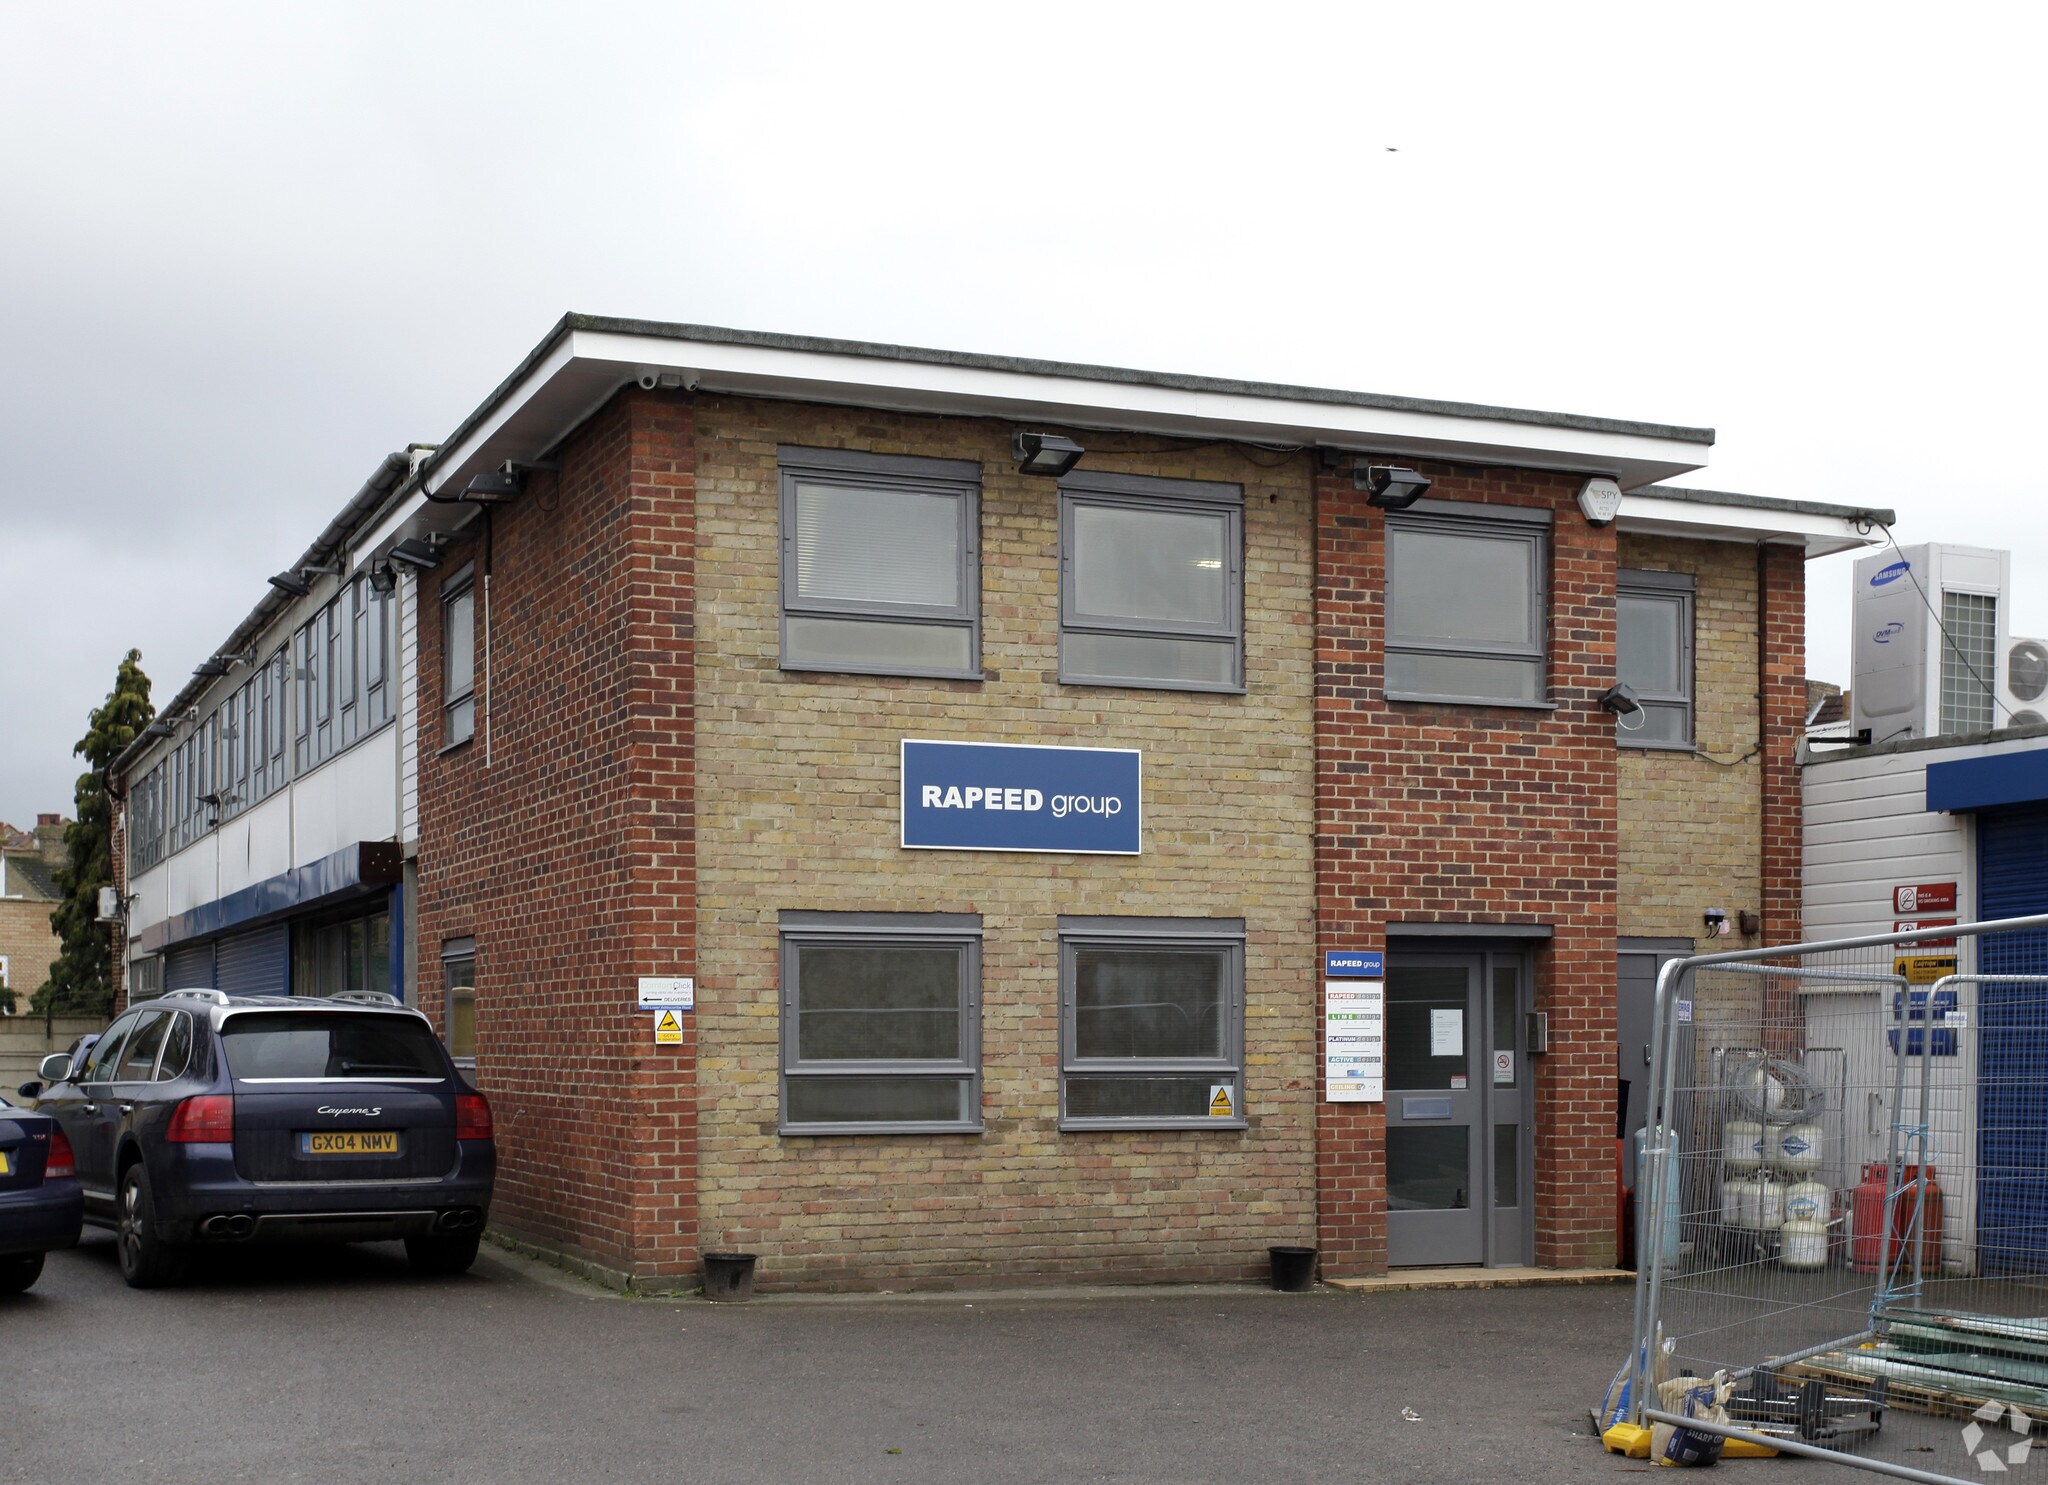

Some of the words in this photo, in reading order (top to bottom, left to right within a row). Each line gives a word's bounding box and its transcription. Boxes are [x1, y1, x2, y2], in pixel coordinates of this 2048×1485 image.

[1601, 490, 1618, 499] SPY
[1875, 567, 1907, 581] SAMSUNG
[922, 785, 1044, 811] RAPEED
[1050, 794, 1122, 818] group
[1330, 959, 1362, 967] RAPEED
[317, 1105, 369, 1118] Cayenne
[365, 1107, 382, 1116] S
[312, 1135, 356, 1150] GX04
[361, 1135, 392, 1149] NMV
[1687, 1430, 1713, 1443] SHARP
